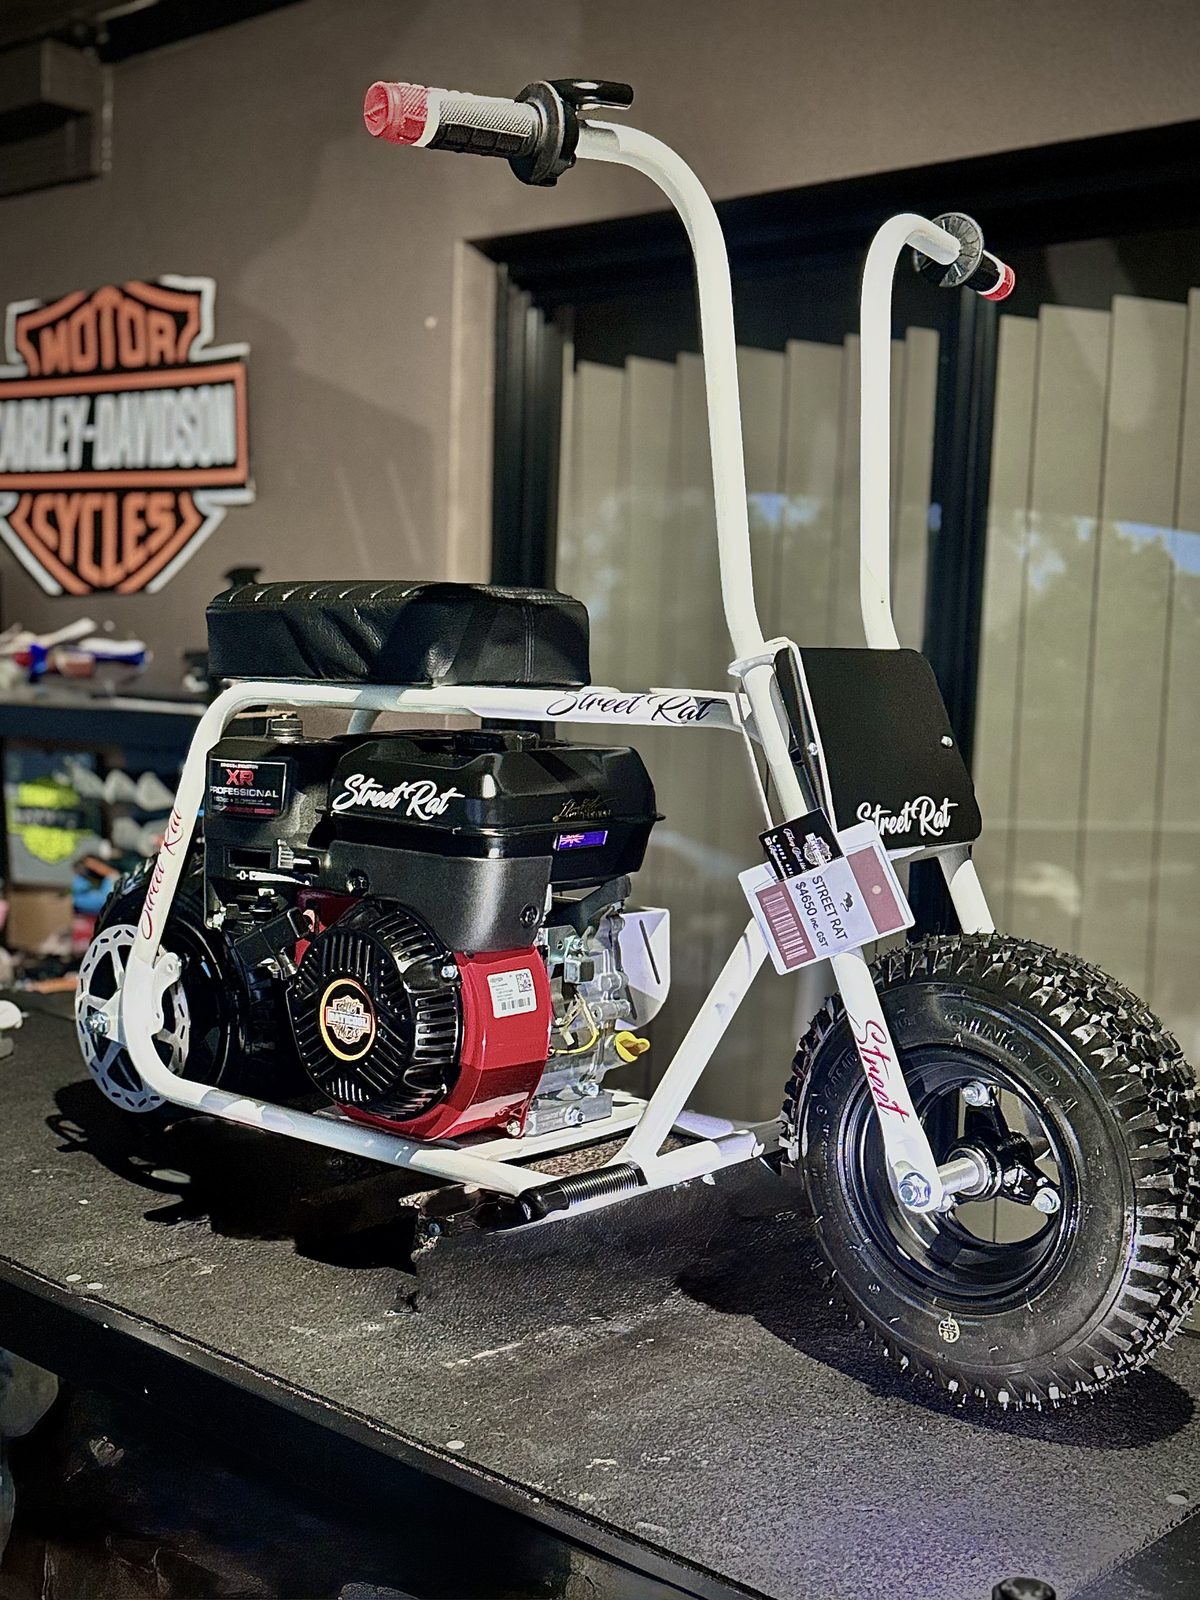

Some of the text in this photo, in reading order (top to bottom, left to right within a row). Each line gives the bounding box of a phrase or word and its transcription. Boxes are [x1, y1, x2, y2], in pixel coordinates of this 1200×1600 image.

[39, 288, 176, 376] MOTOR
[0, 382, 237, 472] ARLEY-DAVIDSON
[31, 491, 177, 588] CYCLES
[546, 691, 730, 724] Street Rat
[209, 786, 279, 798] PROFESSIONAL
[226, 768, 254, 786] XR
[332, 773, 466, 820] Street Rat
[856, 795, 959, 837] Street Rat
[795, 881, 818, 916] $4650
[816, 931, 829, 947] GST
[812, 875, 838, 917] STREET
[830, 918, 848, 940] RAT
[853, 1020, 910, 1124] Street
